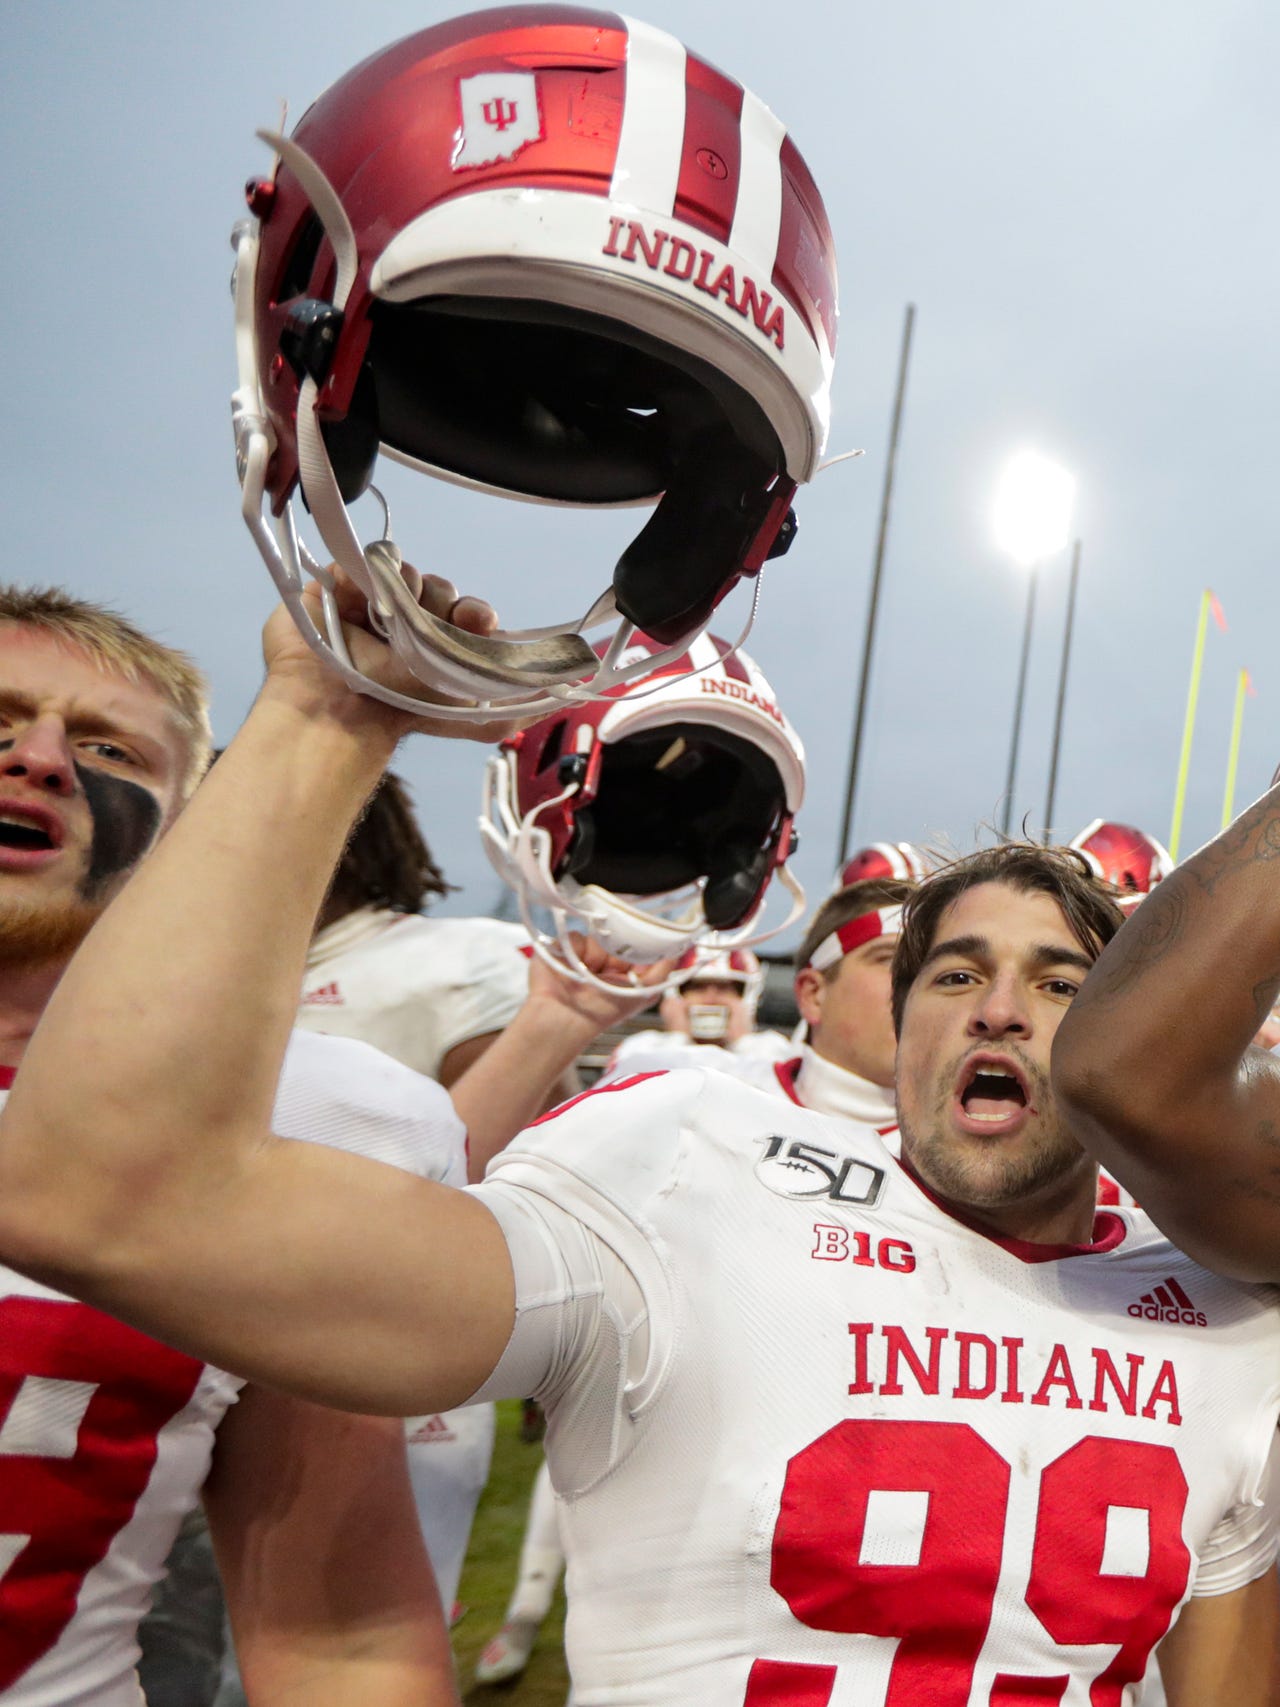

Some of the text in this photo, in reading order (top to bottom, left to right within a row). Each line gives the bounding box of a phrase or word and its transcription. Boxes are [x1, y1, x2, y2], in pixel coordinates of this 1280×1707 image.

[602, 215, 786, 350] INDIANA
[753, 1133, 886, 1207] 150
[1127, 1303, 1208, 1327] adidas
[848, 1322, 1183, 1426] INDIANA
[743, 1418, 1191, 1707] 99
